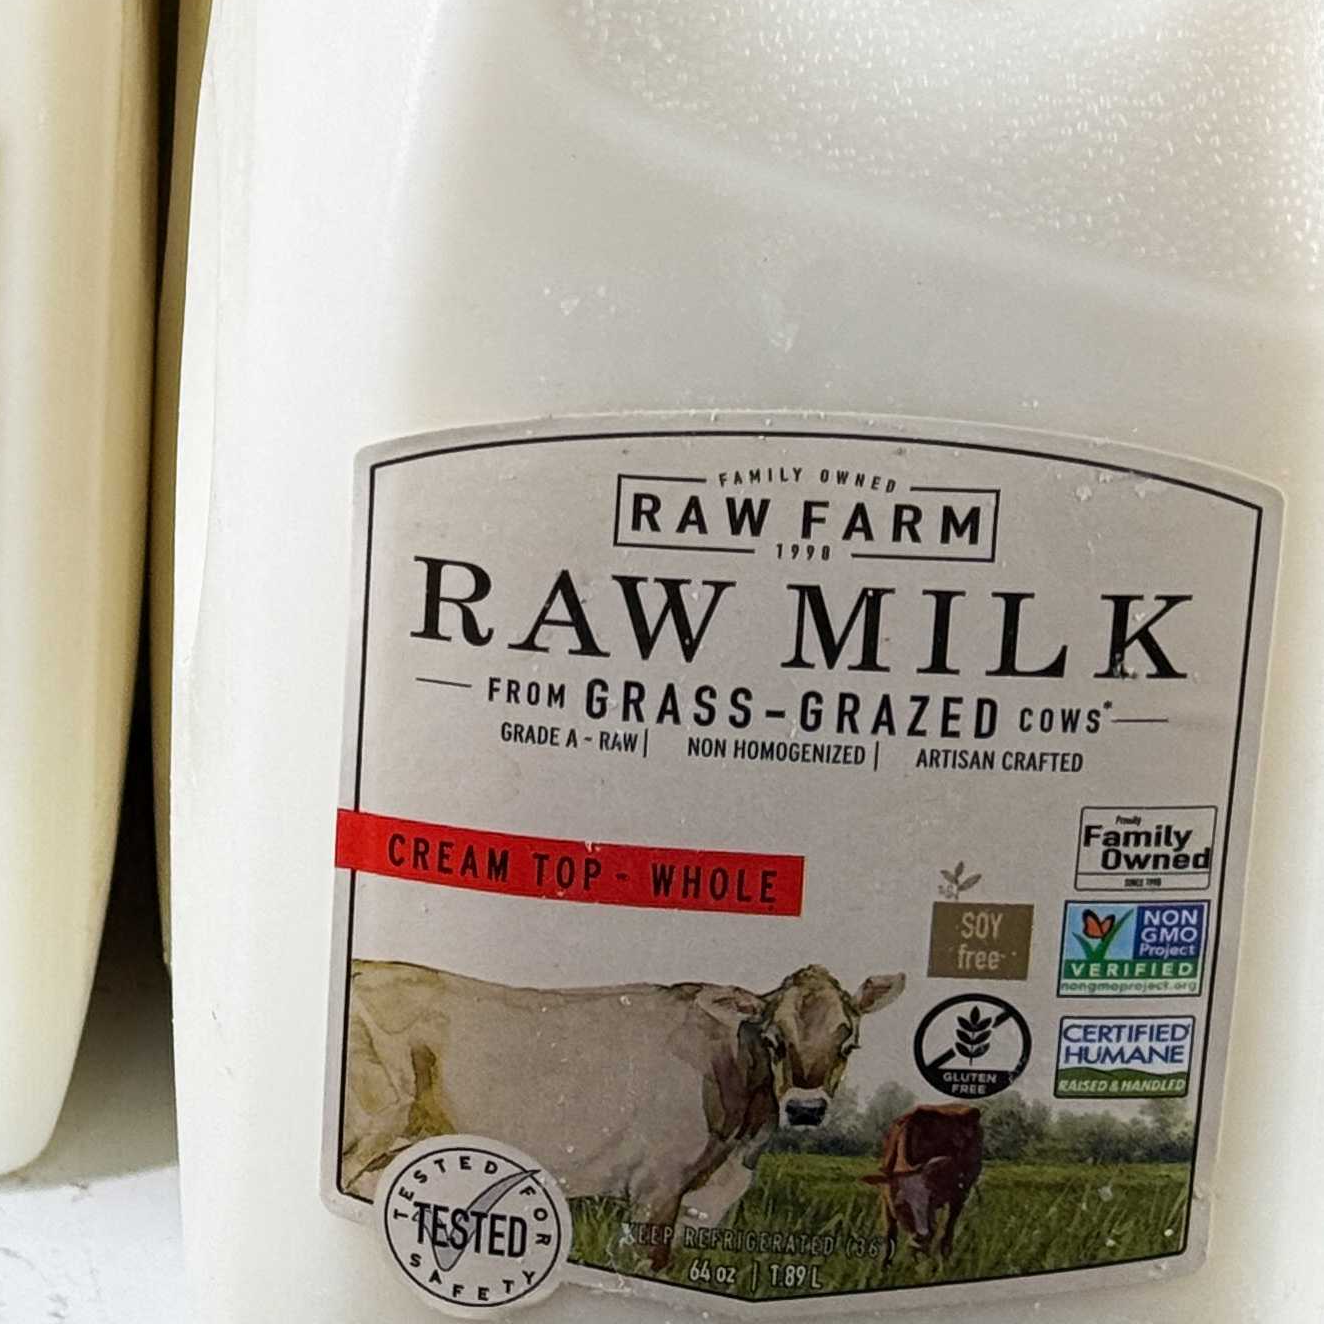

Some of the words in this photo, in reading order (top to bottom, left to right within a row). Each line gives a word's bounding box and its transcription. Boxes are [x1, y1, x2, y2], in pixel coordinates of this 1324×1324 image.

[719, 466, 803, 488] FAMILY
[820, 467, 897, 494] OWNED
[631, 492, 771, 538] RAW
[801, 499, 982, 546] FARM
[776, 542, 832, 562] 1998
[409, 555, 737, 664] RAW
[779, 581, 1198, 681] MILK
[488, 676, 566, 709] FROM
[584, 677, 998, 740] GRASS-GRAZED
[500, 721, 560, 747] GRADE
[565, 728, 578, 749] A
[599, 730, 639, 754] RAW
[687, 736, 728, 759] NON
[733, 738, 866, 766] HOMOGENIZED
[915, 748, 996, 772] ARTISAN
[1001, 750, 1084, 774] CRAFTED
[1083, 824, 1193, 852] Family
[387, 832, 509, 884] CREAM
[532, 852, 602, 892] TOP
[651, 862, 778, 904] WHOLE
[1101, 846, 1211, 870] Owned
[960, 911, 1003, 940] SOY
[1142, 908, 1199, 926] NON
[1140, 925, 1199, 944] GMO
[957, 943, 1001, 971] free
[1138, 941, 1196, 959] Project
[1070, 960, 1195, 977] VERIFIED
[1061, 1022, 1191, 1044] CERTIFIED
[1063, 1043, 1186, 1065] HUMANE
[942, 1070, 998, 1085] GLUTEN
[951, 1082, 987, 1096] FREE
[1057, 1077, 1109, 1093] RAISED
[1120, 1077, 1186, 1094] HANDLED
[392, 1154, 500, 1221] TESTED
[518, 1184, 553, 1247] FOR
[413, 1200, 528, 1259] TESTED
[684, 1223, 834, 1257] REFRIGERATED
[409, 1252, 536, 1302] SAFETY
[688, 1259, 712, 1282] 64
[715, 1267, 737, 1285] oz
[810, 1266, 822, 1289] L
